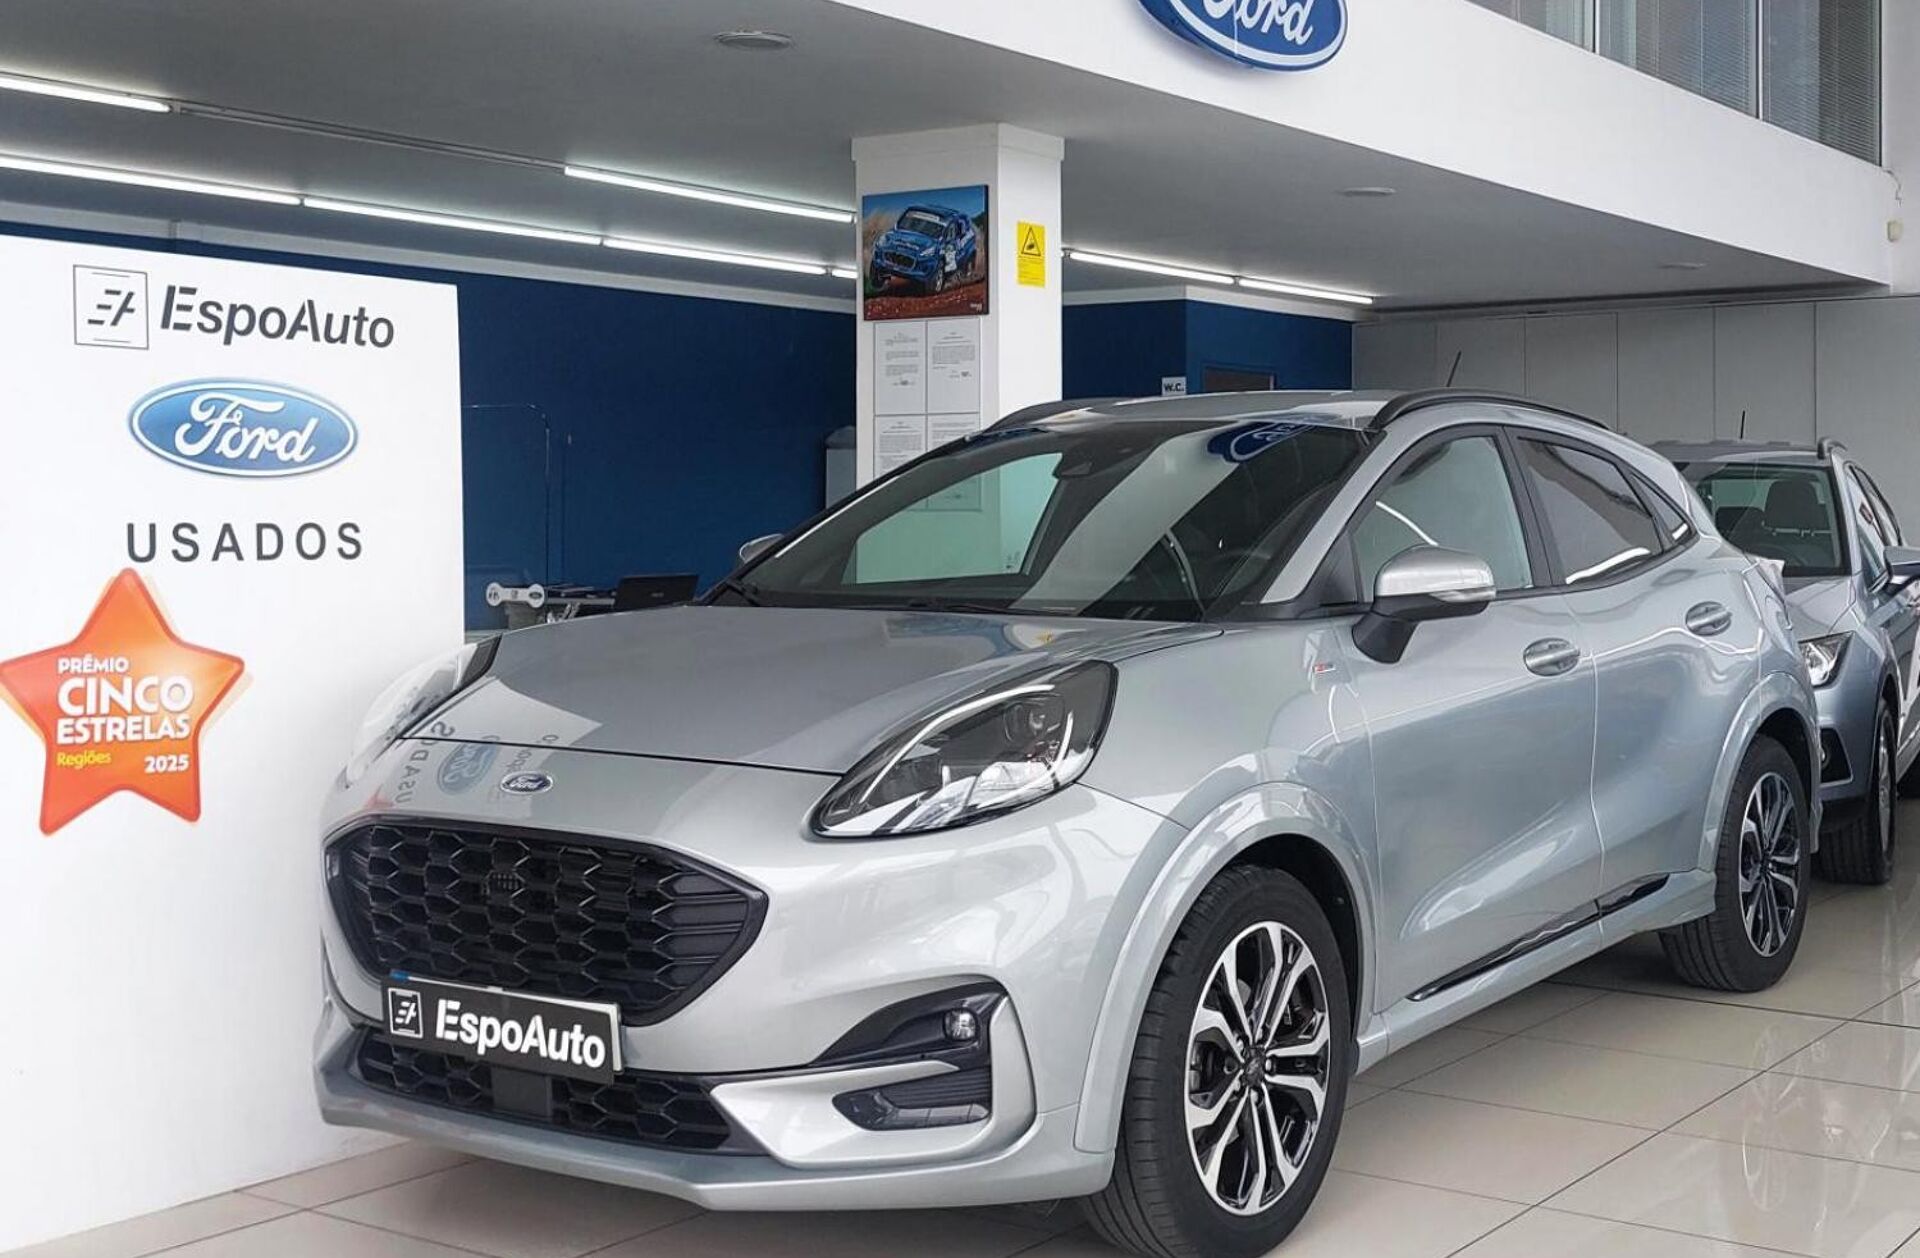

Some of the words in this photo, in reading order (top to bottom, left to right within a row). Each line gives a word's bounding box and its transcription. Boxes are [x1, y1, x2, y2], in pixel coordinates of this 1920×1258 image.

[160, 284, 395, 348] EspoAuto
[174, 392, 320, 462] Ford
[127, 522, 363, 563] USADOS
[57, 675, 194, 717] CINCO
[57, 715, 191, 745] ESTRELAS
[57, 750, 112, 770] Regiões
[144, 755, 190, 774] 2025
[436, 998, 606, 1068] EspoAuto
